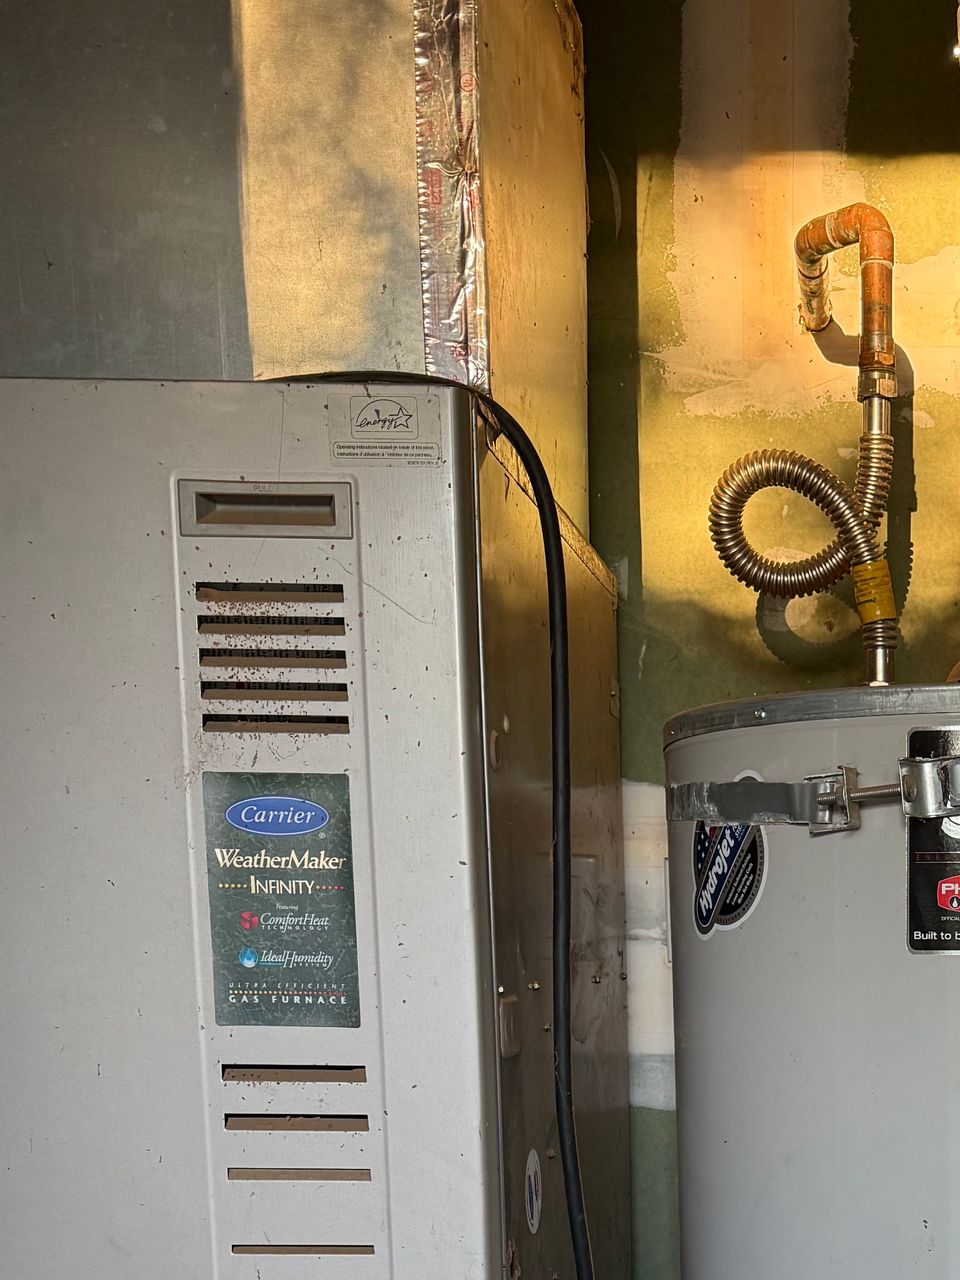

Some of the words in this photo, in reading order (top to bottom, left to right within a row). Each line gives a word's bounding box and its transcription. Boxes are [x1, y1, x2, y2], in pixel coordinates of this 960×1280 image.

[241, 806, 315, 823] Carrier
[215, 848, 346, 869] WeatherMaker
[700, 828, 735, 917] Hydrojet
[250, 875, 315, 894] INFINITY
[260, 912, 329, 933] ComfortHeat
[914, 931, 938, 940] Built
[940, 932, 951, 940] to
[261, 951, 333, 970] IdealHumidity
[229, 995, 259, 1003] GAS
[272, 996, 347, 1004] FURNACE
